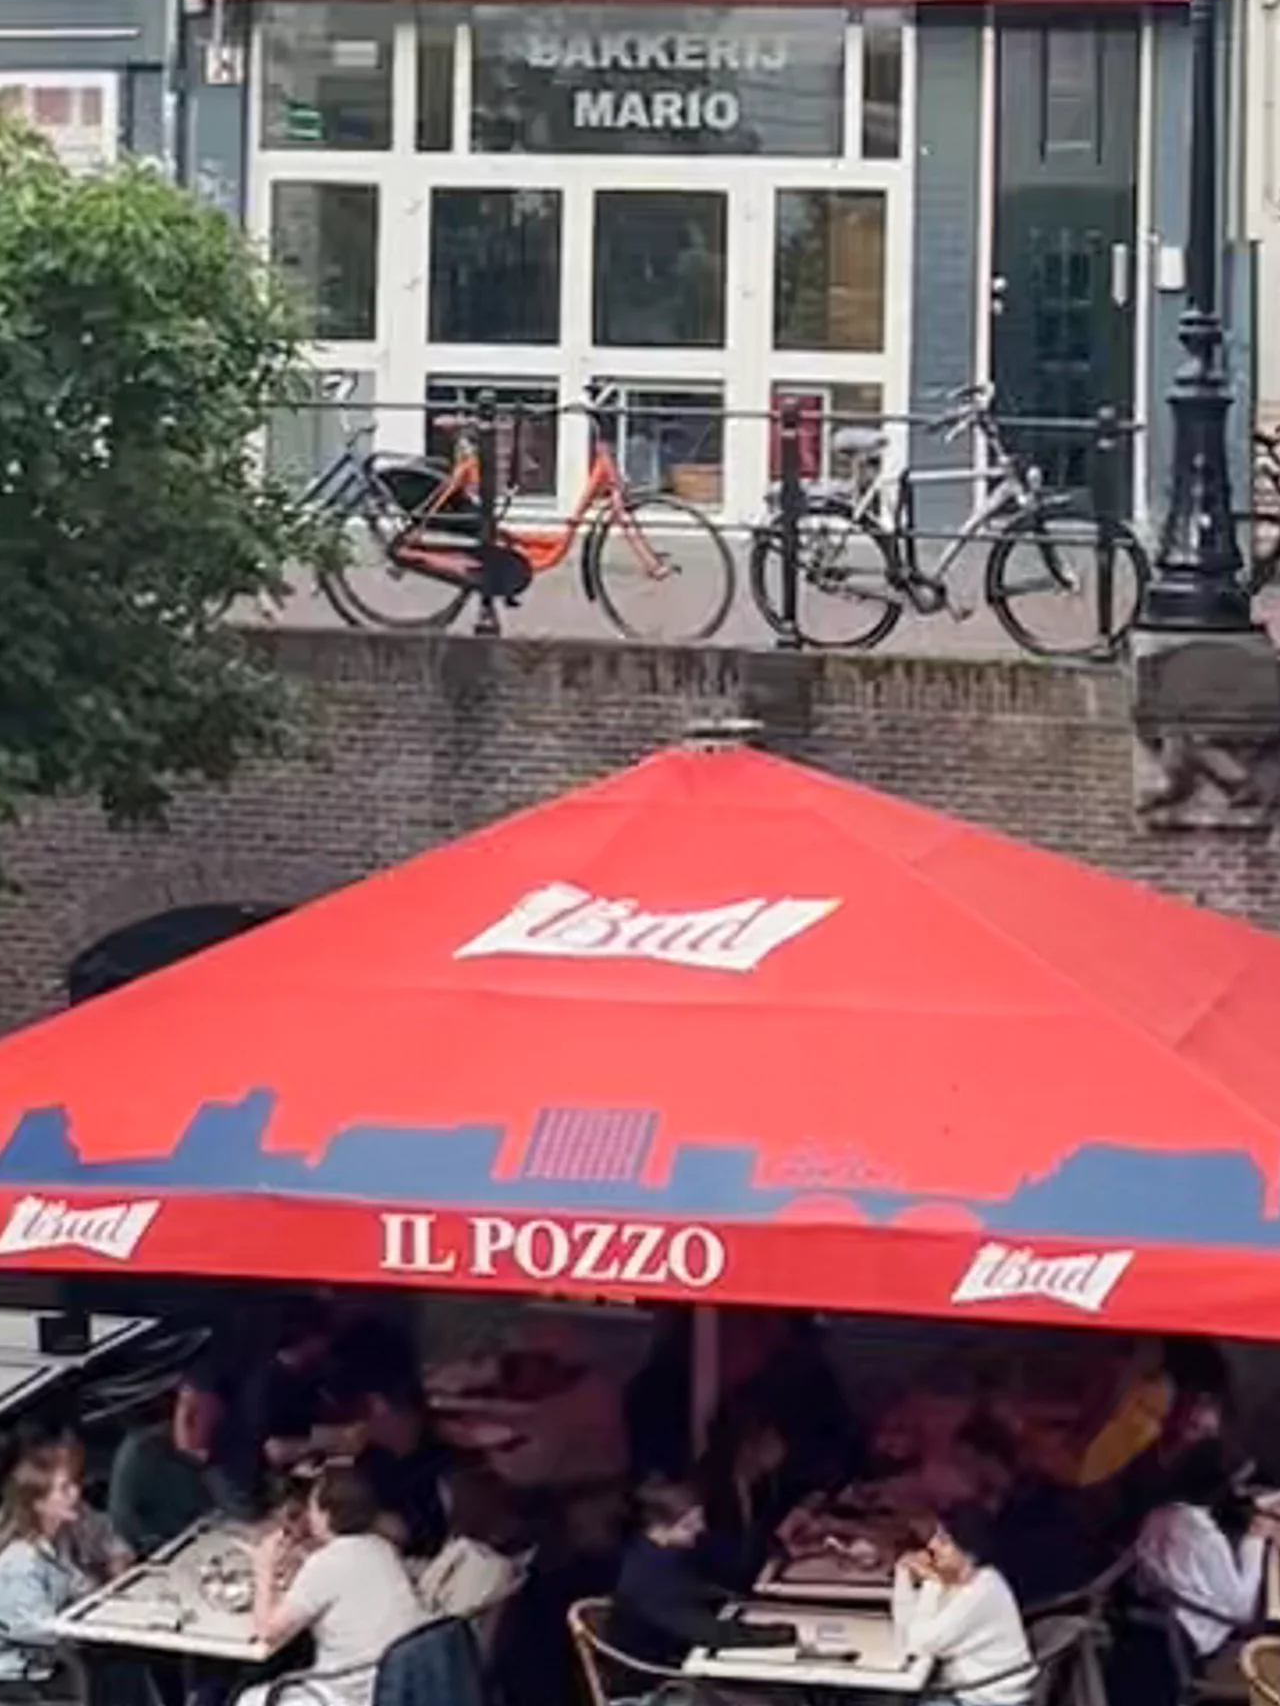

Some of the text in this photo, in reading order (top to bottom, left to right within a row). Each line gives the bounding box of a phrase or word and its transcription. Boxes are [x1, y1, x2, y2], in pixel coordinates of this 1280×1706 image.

[525, 34, 789, 69] BAKKERIJ
[573, 90, 740, 130] MARIO
[378, 1212, 725, 1287] IL POZZO
